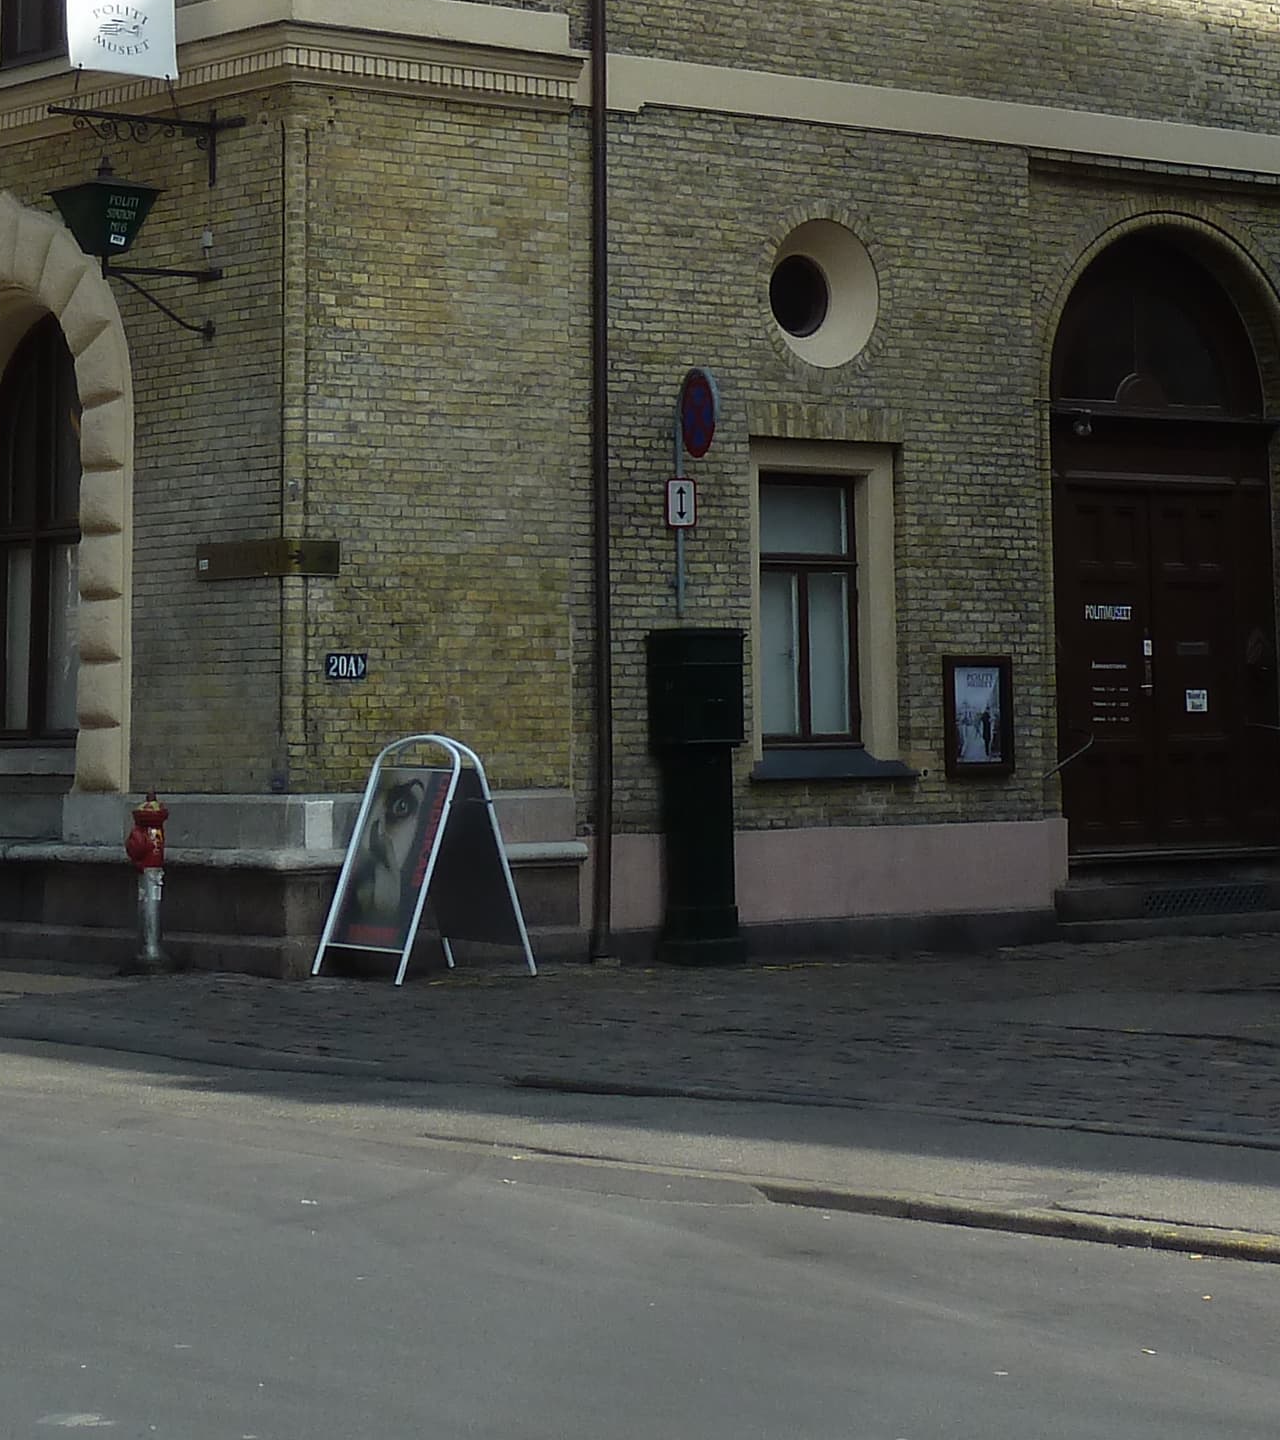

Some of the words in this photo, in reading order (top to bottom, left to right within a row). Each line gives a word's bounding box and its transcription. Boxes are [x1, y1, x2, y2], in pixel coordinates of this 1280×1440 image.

[92, 3, 149, 25] POLITI
[92, 34, 150, 56] MUSEET
[108, 194, 139, 208] POLITI
[105, 207, 137, 221] STATION
[1084, 604, 1132, 621] POLITIMUSEET
[328, 654, 357, 677] 20A
